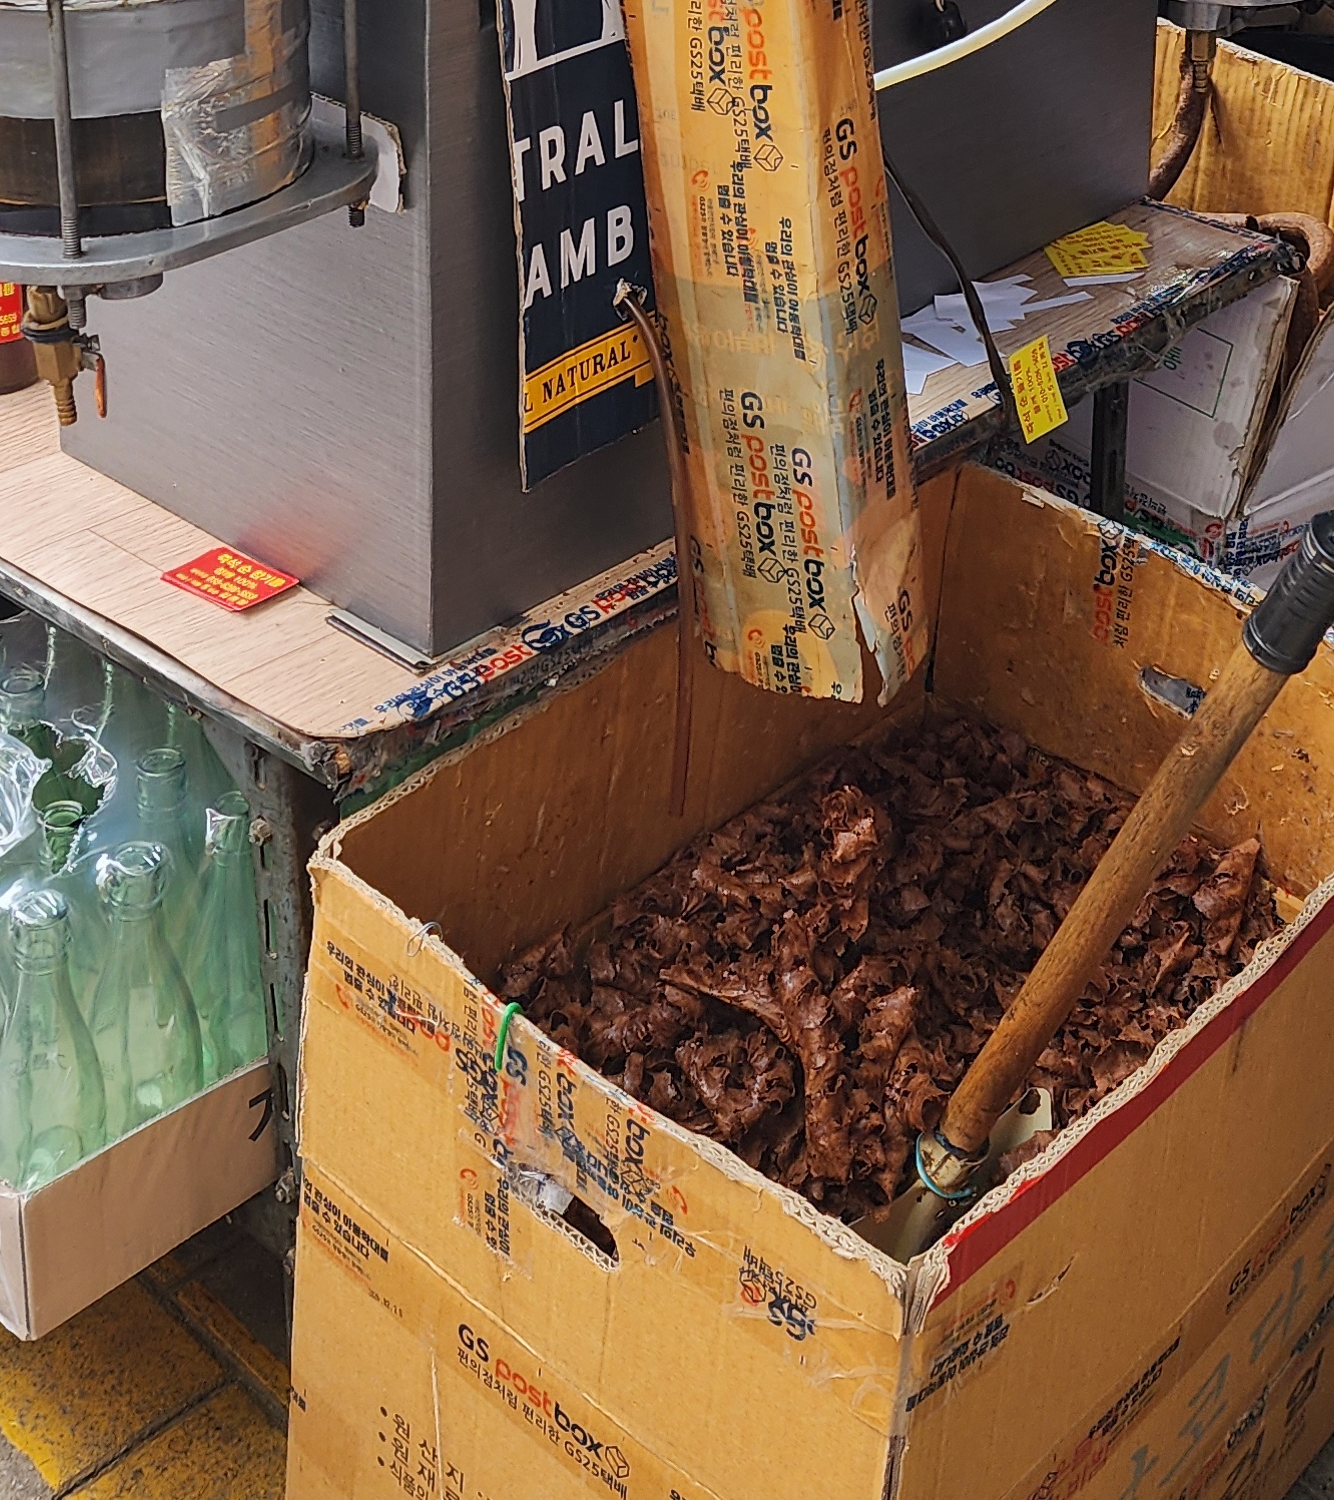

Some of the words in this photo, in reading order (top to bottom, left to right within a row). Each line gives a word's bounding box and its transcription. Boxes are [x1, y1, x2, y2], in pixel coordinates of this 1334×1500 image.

[690, 37, 706, 112] GS25택배
[726, 45, 744, 91] 편리한
[741, 8, 773, 142] postbox
[835, 118, 857, 161] GS
[730, 160, 746, 200] 우리의
[823, 127, 843, 208] 편의점처럼
[717, 185, 732, 210] 멈출
[720, 214, 733, 227] 수
[721, 229, 739, 277] 있습니다
[765, 241, 780, 266] 멈출
[779, 217, 793, 257] 우리의
[834, 210, 851, 259] 편리한
[840, 166, 871, 296] postbox
[524, 205, 635, 309] AMB
[770, 269, 783, 282] 수
[782, 260, 798, 296] 관심이
[773, 285, 788, 334] 있습니다
[837, 261, 857, 336] GS25택배
[787, 298, 806, 362] 아동학대를
[539, 342, 630, 403] NATURAL
[719, 388, 744, 460] 편의점처럼
[741, 391, 765, 431] GS
[769, 444, 792, 514] 편의점처럼
[792, 448, 813, 488] GS
[872, 435, 885, 483] 있습니다
[729, 463, 748, 507] 편리한
[741, 434, 776, 558] postbox
[736, 510, 756, 579] GS25택배
[779, 519, 798, 565] 편리한
[793, 490, 827, 614] postbox
[899, 590, 914, 633] GS
[326, 940, 355, 973] 우리의
[355, 963, 386, 997] 관심이
[313, 1186, 342, 1220] 관심이
[343, 1211, 390, 1264] 아동학대를
[333, 1220, 371, 1261] 있습니다
[1228, 1258, 1252, 1297] GS
[458, 1323, 490, 1363] GS
[495, 1358, 604, 1463] postbox
[457, 1347, 520, 1411] 편의점처럼
[522, 1402, 562, 1447] 편리한
[564, 1440, 629, 1500] GS25택배
